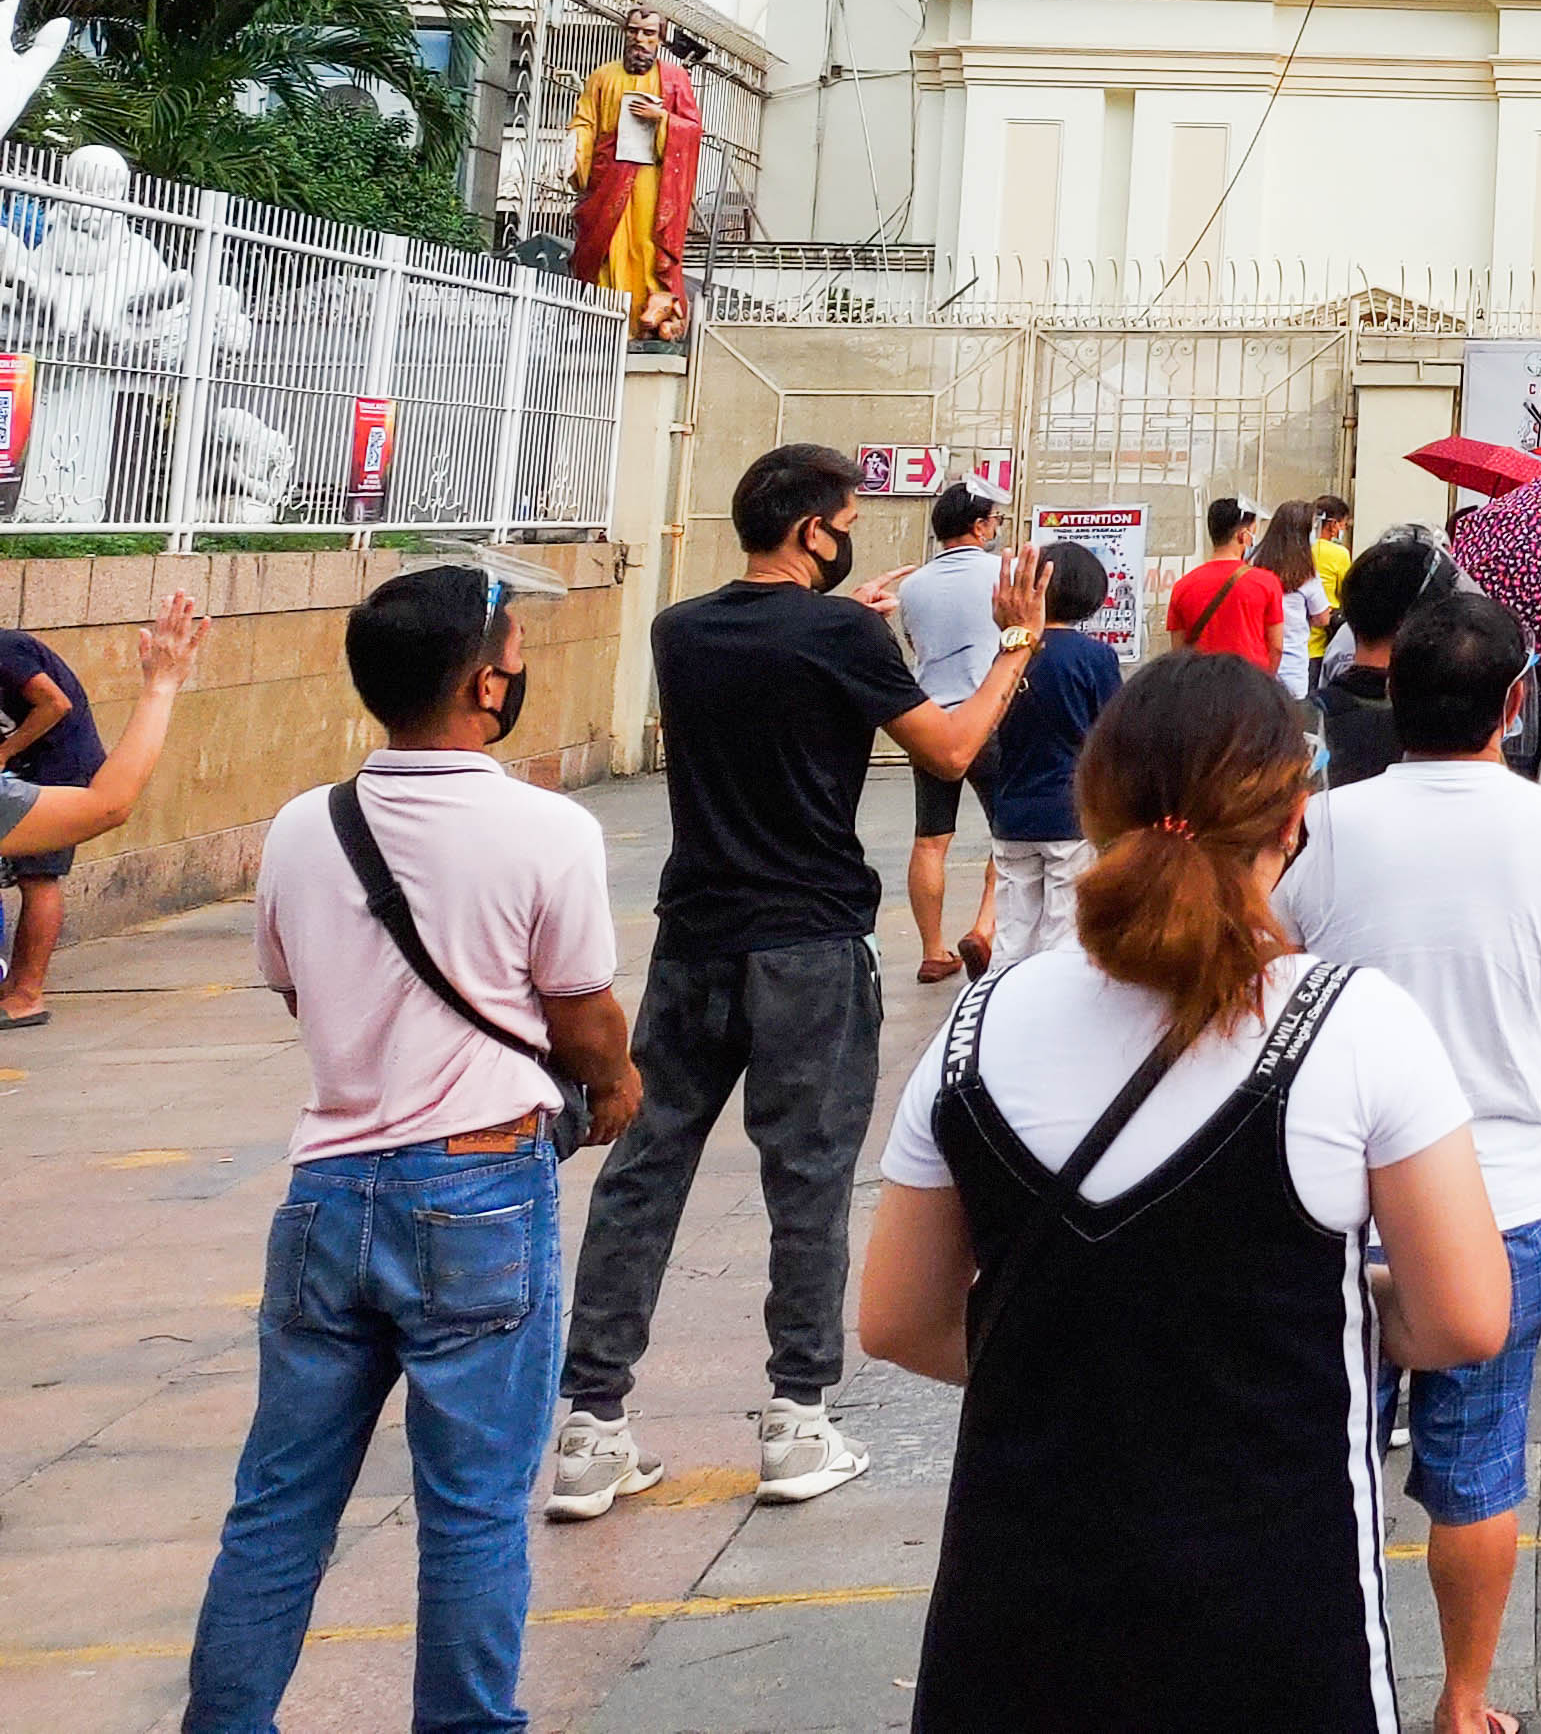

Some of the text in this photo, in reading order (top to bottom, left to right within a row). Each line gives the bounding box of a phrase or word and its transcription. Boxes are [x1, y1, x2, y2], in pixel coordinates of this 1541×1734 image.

[1060, 513, 1133, 525] ATTENTION
[1269, 1010, 1305, 1047] WILL
[1283, 1019, 1315, 1061] Weight
